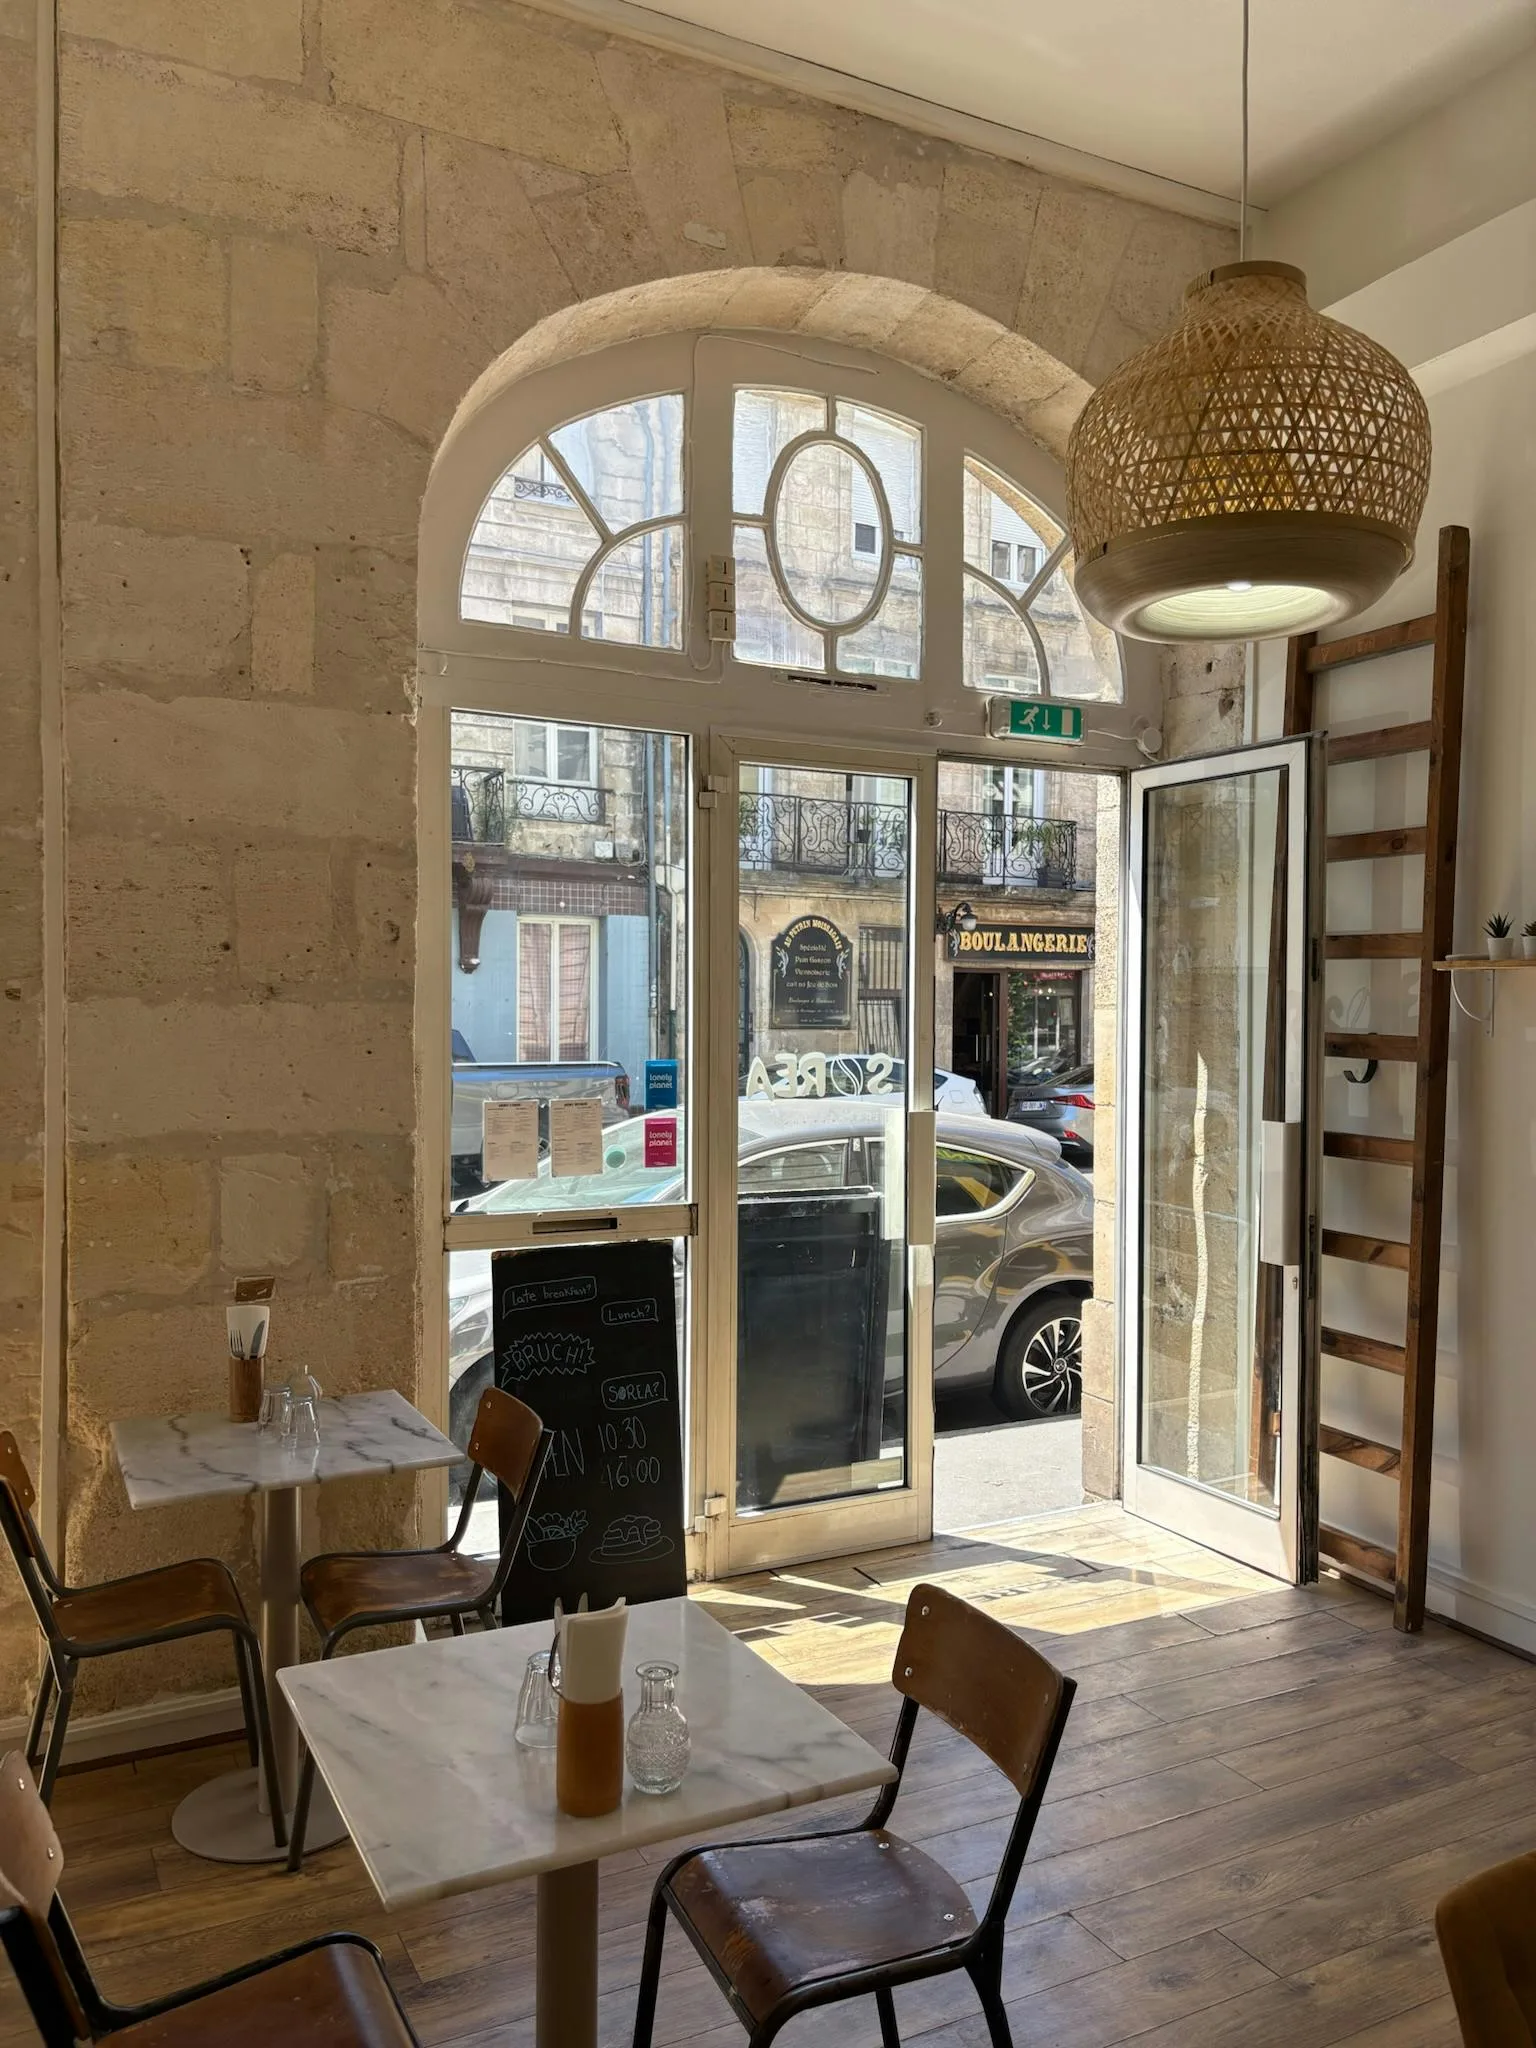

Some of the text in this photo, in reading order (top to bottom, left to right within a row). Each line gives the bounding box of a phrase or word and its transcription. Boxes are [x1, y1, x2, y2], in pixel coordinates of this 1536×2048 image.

[959, 931, 1088, 954] BOULANGERIE
[649, 1072, 673, 1082] lonely
[649, 1082, 673, 1090] planet
[649, 1131, 673, 1140] lonely
[649, 1139, 673, 1148] planet
[608, 1304, 651, 1322] Lunch?
[512, 1343, 585, 1372] BRUCH!
